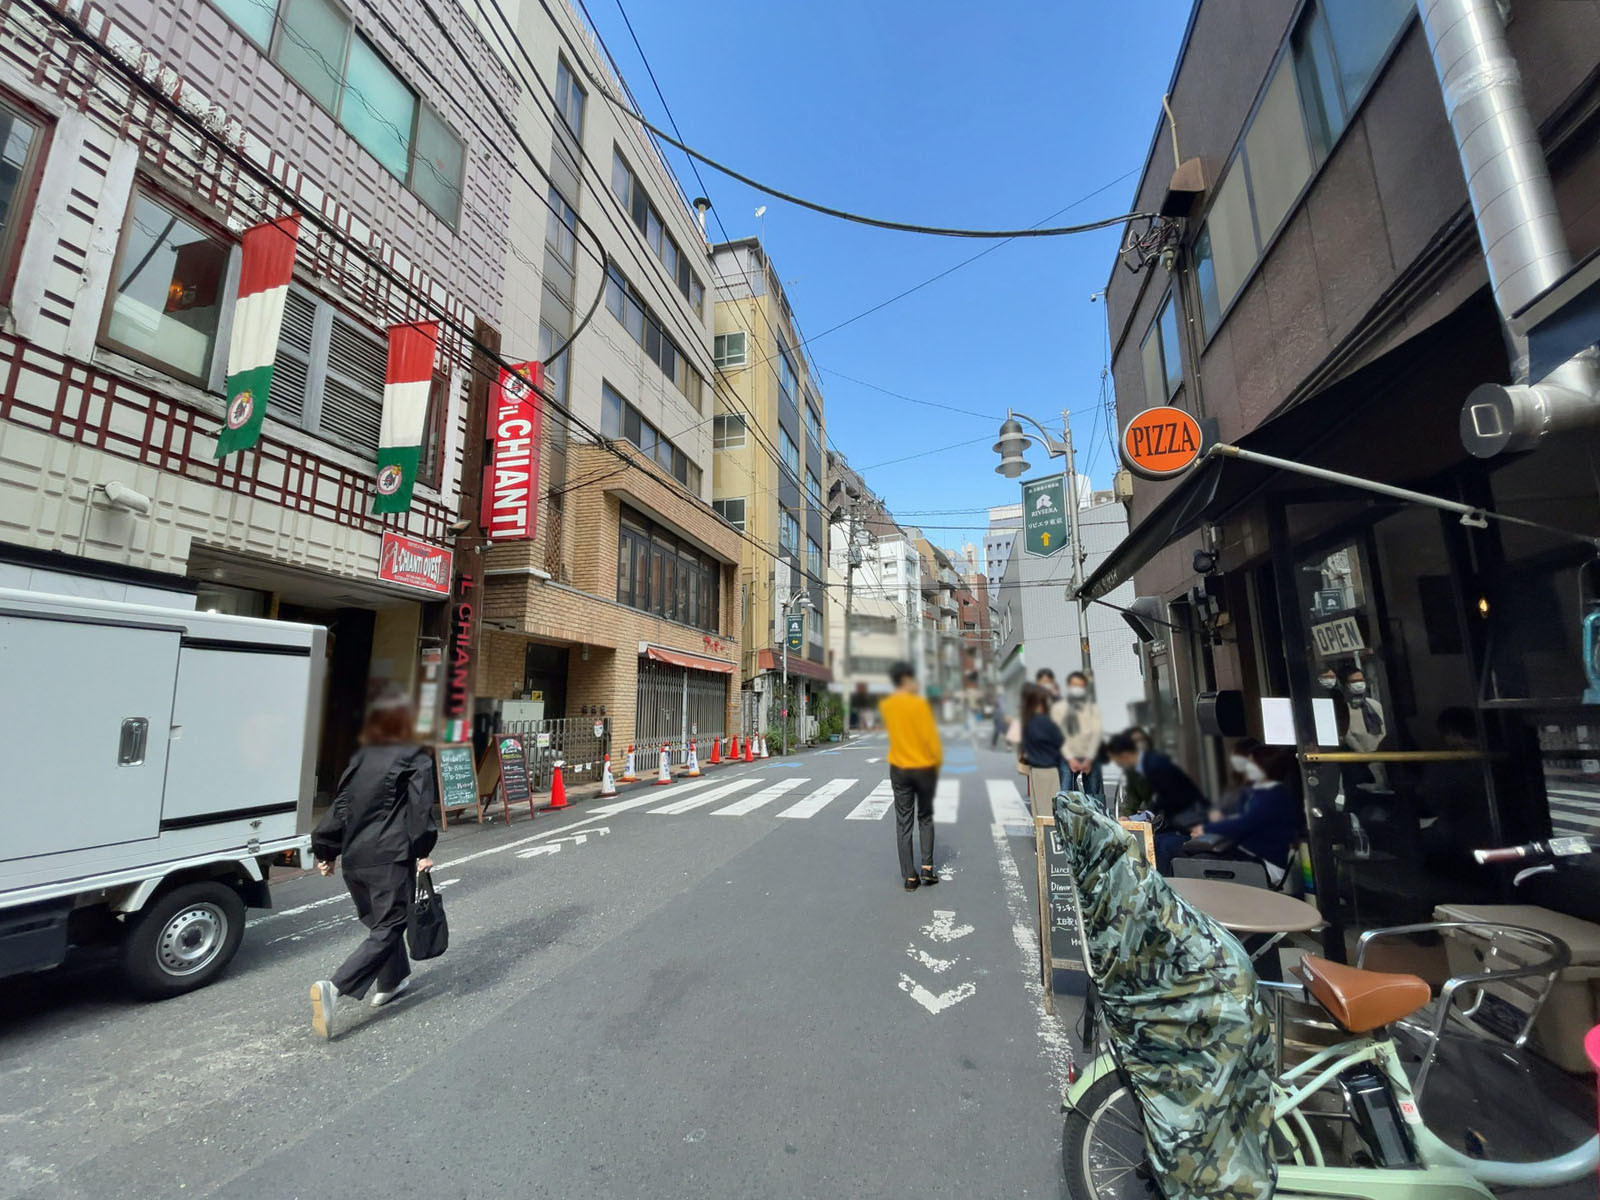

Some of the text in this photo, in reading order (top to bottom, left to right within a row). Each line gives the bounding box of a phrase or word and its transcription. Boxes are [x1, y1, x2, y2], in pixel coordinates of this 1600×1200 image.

[1132, 421, 1196, 457] PIZZA
[491, 419, 532, 538] CHIANTI
[1031, 507, 1058, 517] RIVIERA
[423, 554, 442, 583] OVEST
[1316, 621, 1360, 651] OPEN
[451, 603, 474, 713] CHIANTI
